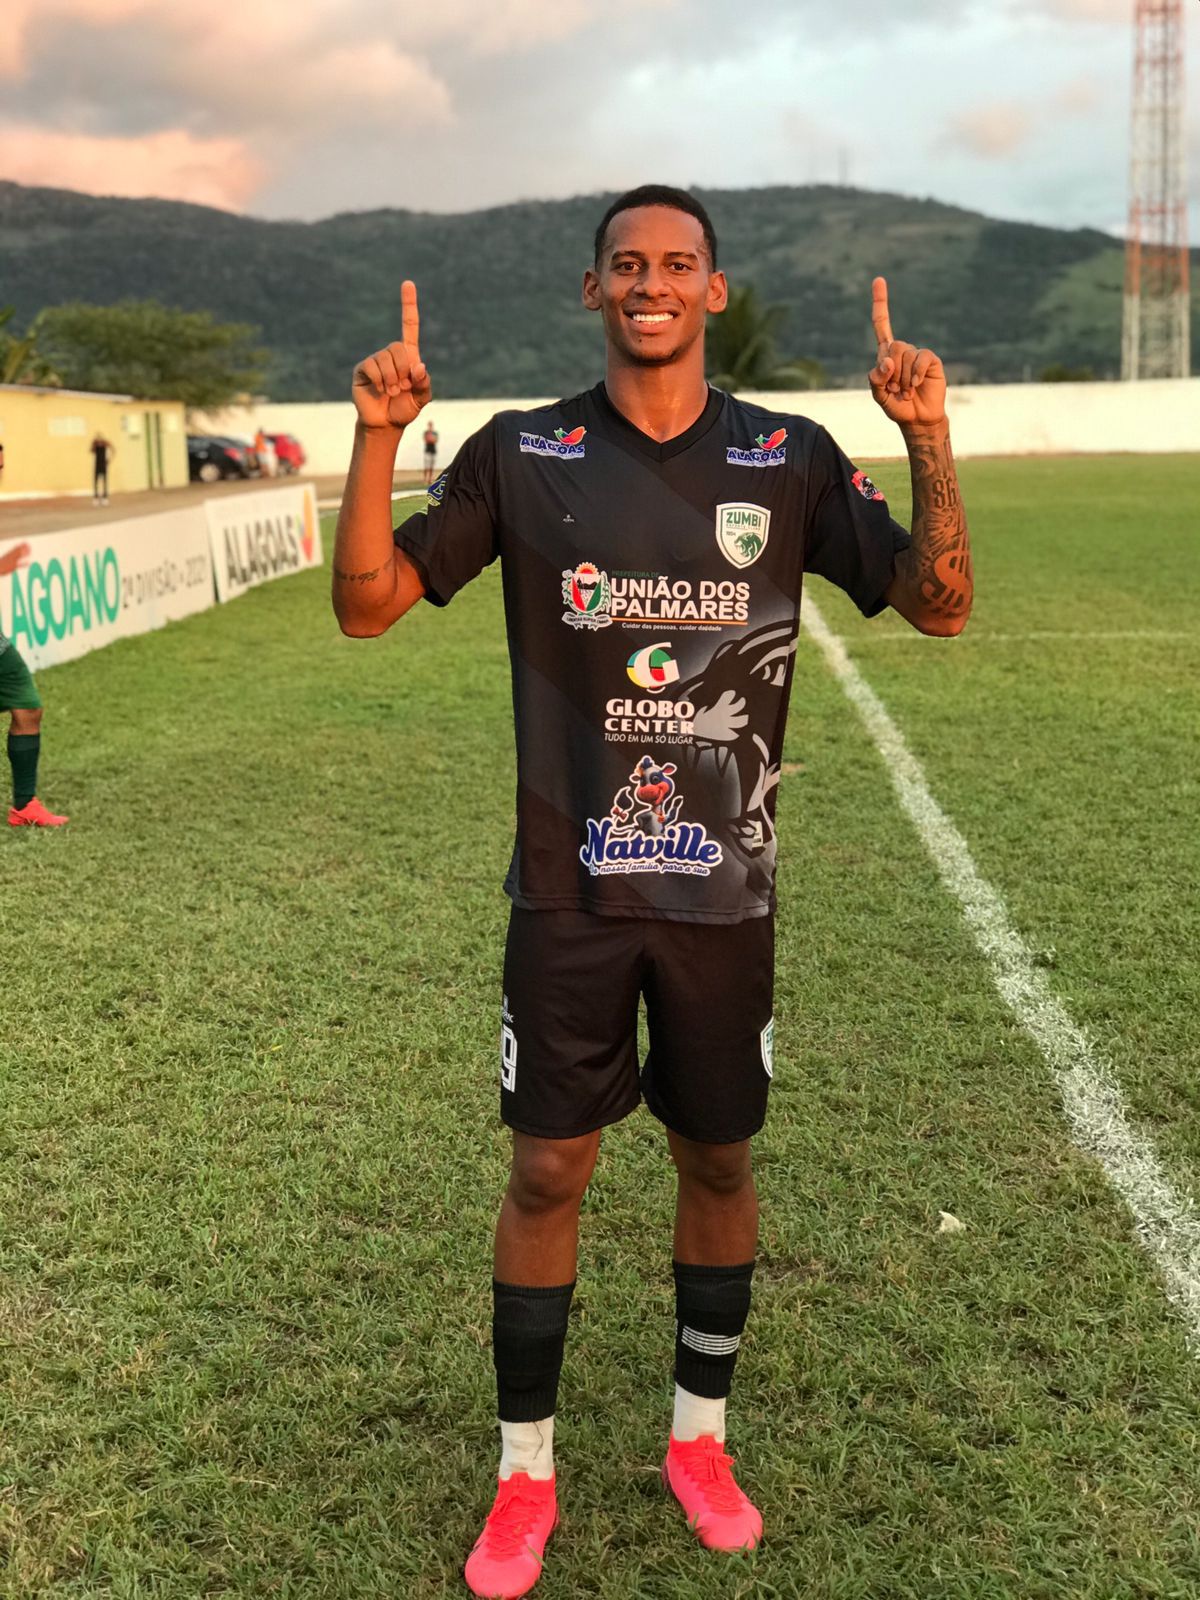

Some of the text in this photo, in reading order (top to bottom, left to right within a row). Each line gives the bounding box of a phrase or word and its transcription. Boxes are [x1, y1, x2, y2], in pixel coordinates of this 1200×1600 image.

[520, 435, 585, 455] ALAGOAS
[728, 447, 786, 462] ALAGOAS
[726, 511, 762, 527] ZUMBI
[222, 514, 299, 589] ALAGOAS
[611, 575, 750, 601] UNIÃO DOS
[611, 597, 749, 620] PALMARES
[606, 698, 695, 719] GLOBO
[604, 717, 695, 735] CENTER
[604, 733, 626, 742] TUDO
[627, 734, 639, 742] EM
[640, 735, 653, 743] UM
[668, 736, 694, 745] LUGAR
[580, 819, 722, 865] Natville
[600, 865, 626, 873] nossa
[660, 863, 683, 873] para
[692, 866, 709, 875] sua
[502, 1024, 518, 1093] 9
